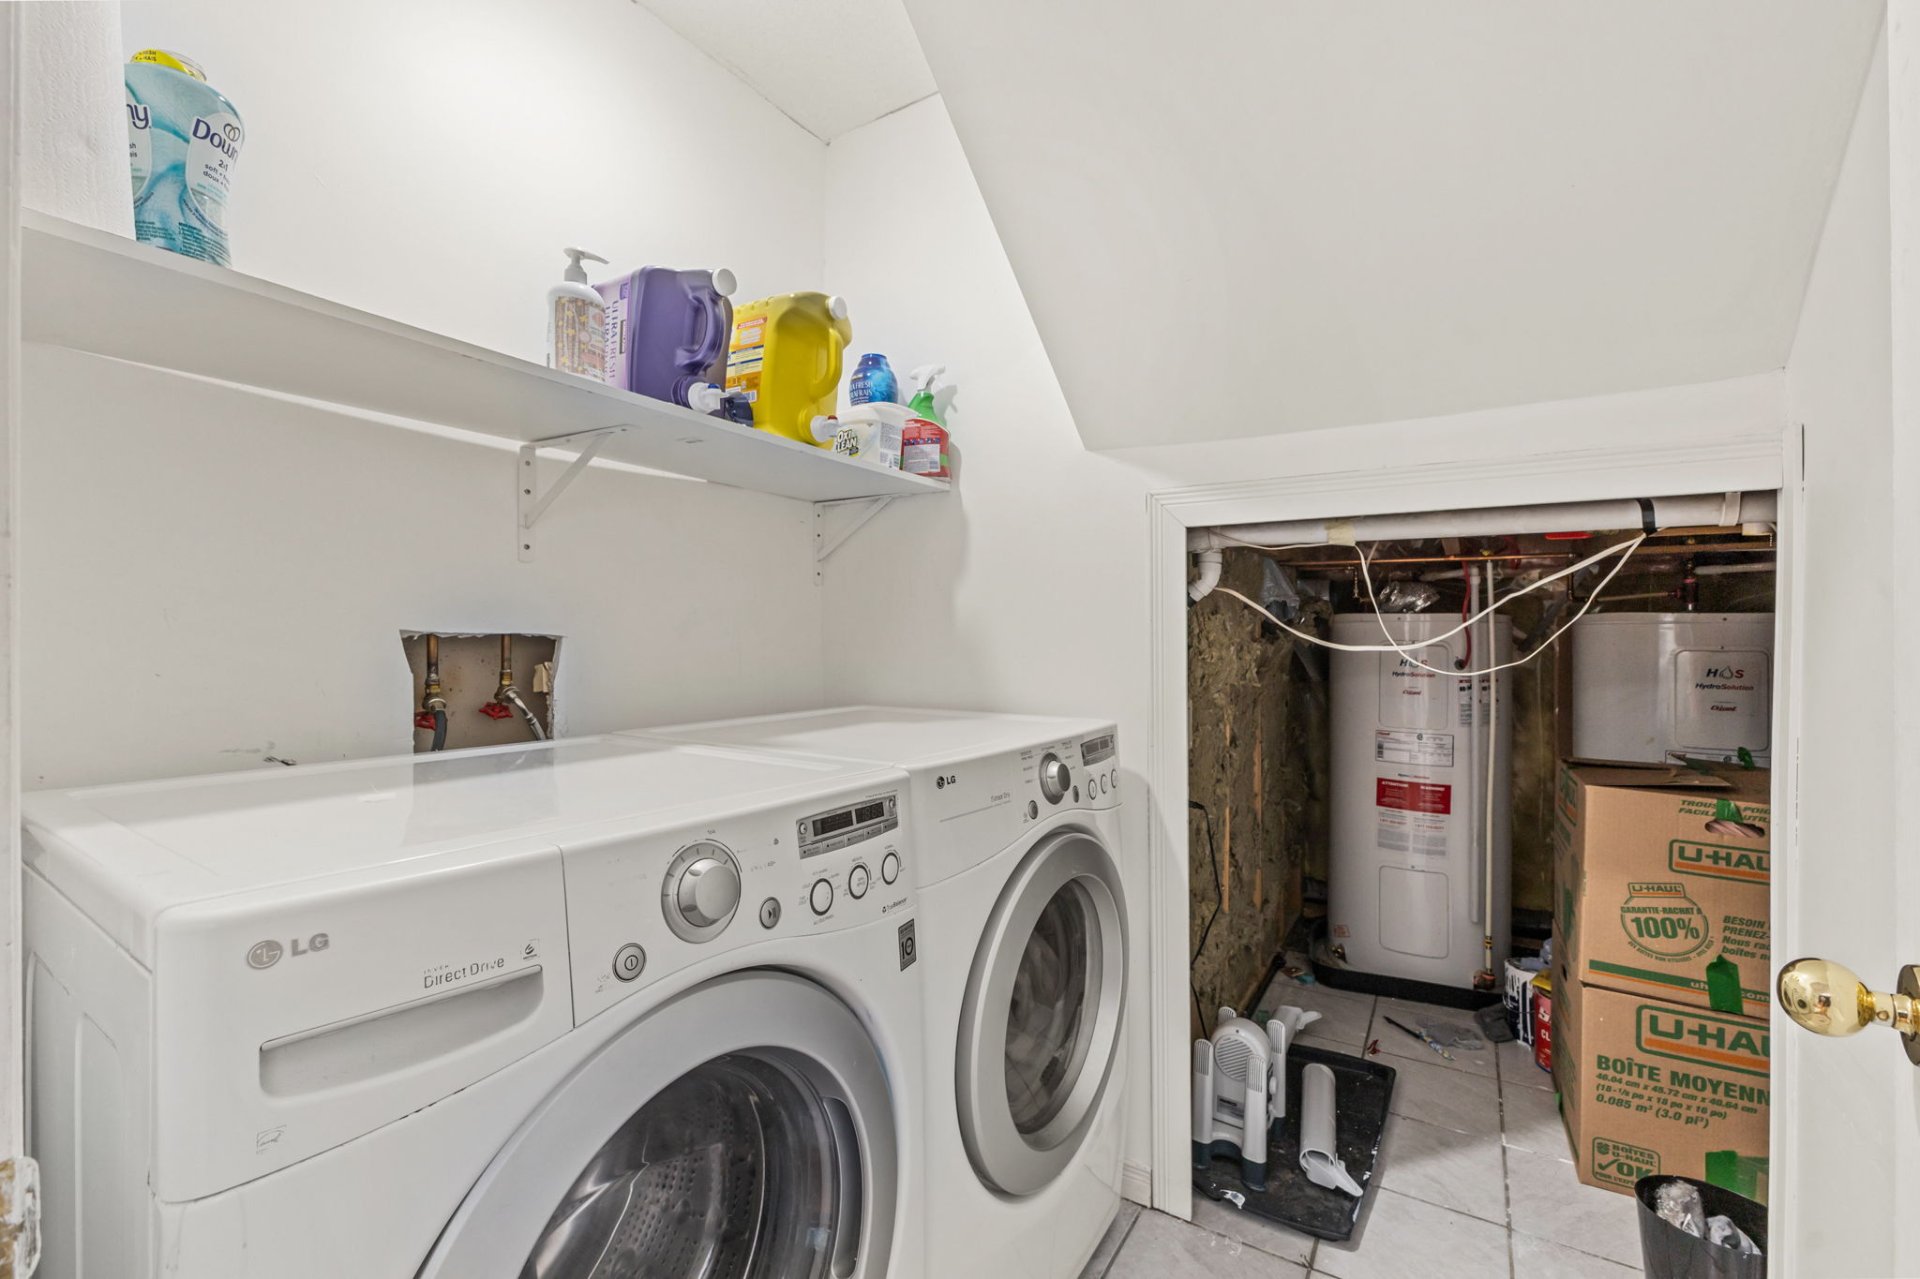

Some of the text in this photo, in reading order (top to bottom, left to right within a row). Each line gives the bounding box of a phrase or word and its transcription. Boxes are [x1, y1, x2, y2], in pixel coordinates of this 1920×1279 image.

[192, 117, 239, 163] Down
[836, 437, 858, 453] LEAN
[837, 429, 853, 442] OXI
[1695, 682, 1754, 690] HydroSolution
[946, 775, 956, 786] LG
[1631, 884, 1683, 892] U-HAUL
[1631, 916, 1700, 940] 100%
[1723, 915, 1766, 929] BESOIN
[290, 932, 331, 958] LG
[901, 937, 914, 960] 10
[1722, 935, 1751, 947] Nous
[424, 967, 467, 989] Direct
[1649, 1014, 1770, 1057] U-HA
[1596, 1055, 1661, 1083] BOÎTE
[1596, 1094, 1632, 1109] 0.085
[1655, 1107, 1682, 1121] (3.0
[1625, 1080, 1640, 1089] cm
[1652, 1085, 1680, 1097] 45.72
[1682, 1092, 1698, 1101] cm
[1709, 1097, 1739, 1110] 40.64
[1741, 1105, 1757, 1114] cm
[1632, 1092, 1644, 1101] po
[1656, 1096, 1668, 1106] 18
[1670, 1101, 1684, 1110] po
[1696, 1105, 1708, 1115] 16
[1709, 1108, 1727, 1119] po)
[1612, 1151, 1657, 1168] U-HAUL
[1616, 1161, 1654, 1180] OK
